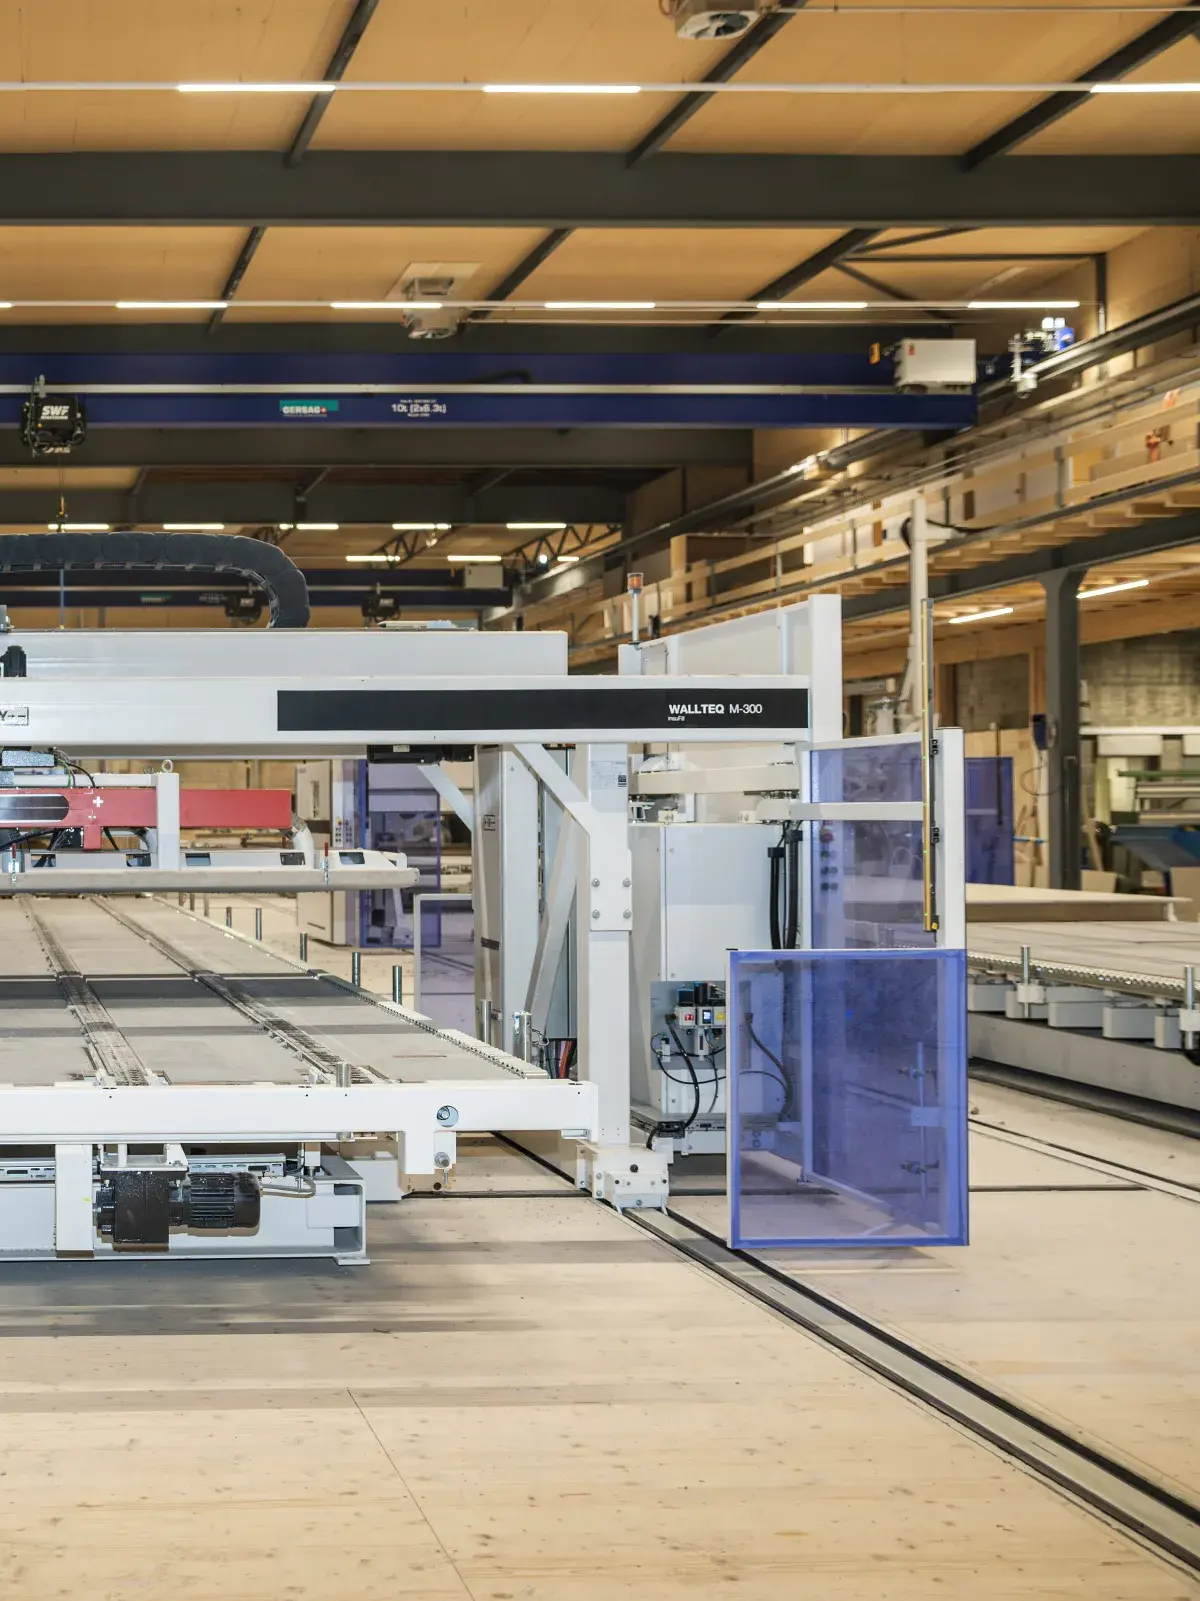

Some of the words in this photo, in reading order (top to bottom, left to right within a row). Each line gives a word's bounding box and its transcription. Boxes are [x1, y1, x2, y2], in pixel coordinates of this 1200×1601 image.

[41, 405, 70, 416] SWF
[668, 704, 725, 714] WALLTEQ
[729, 703, 763, 714] M-300
